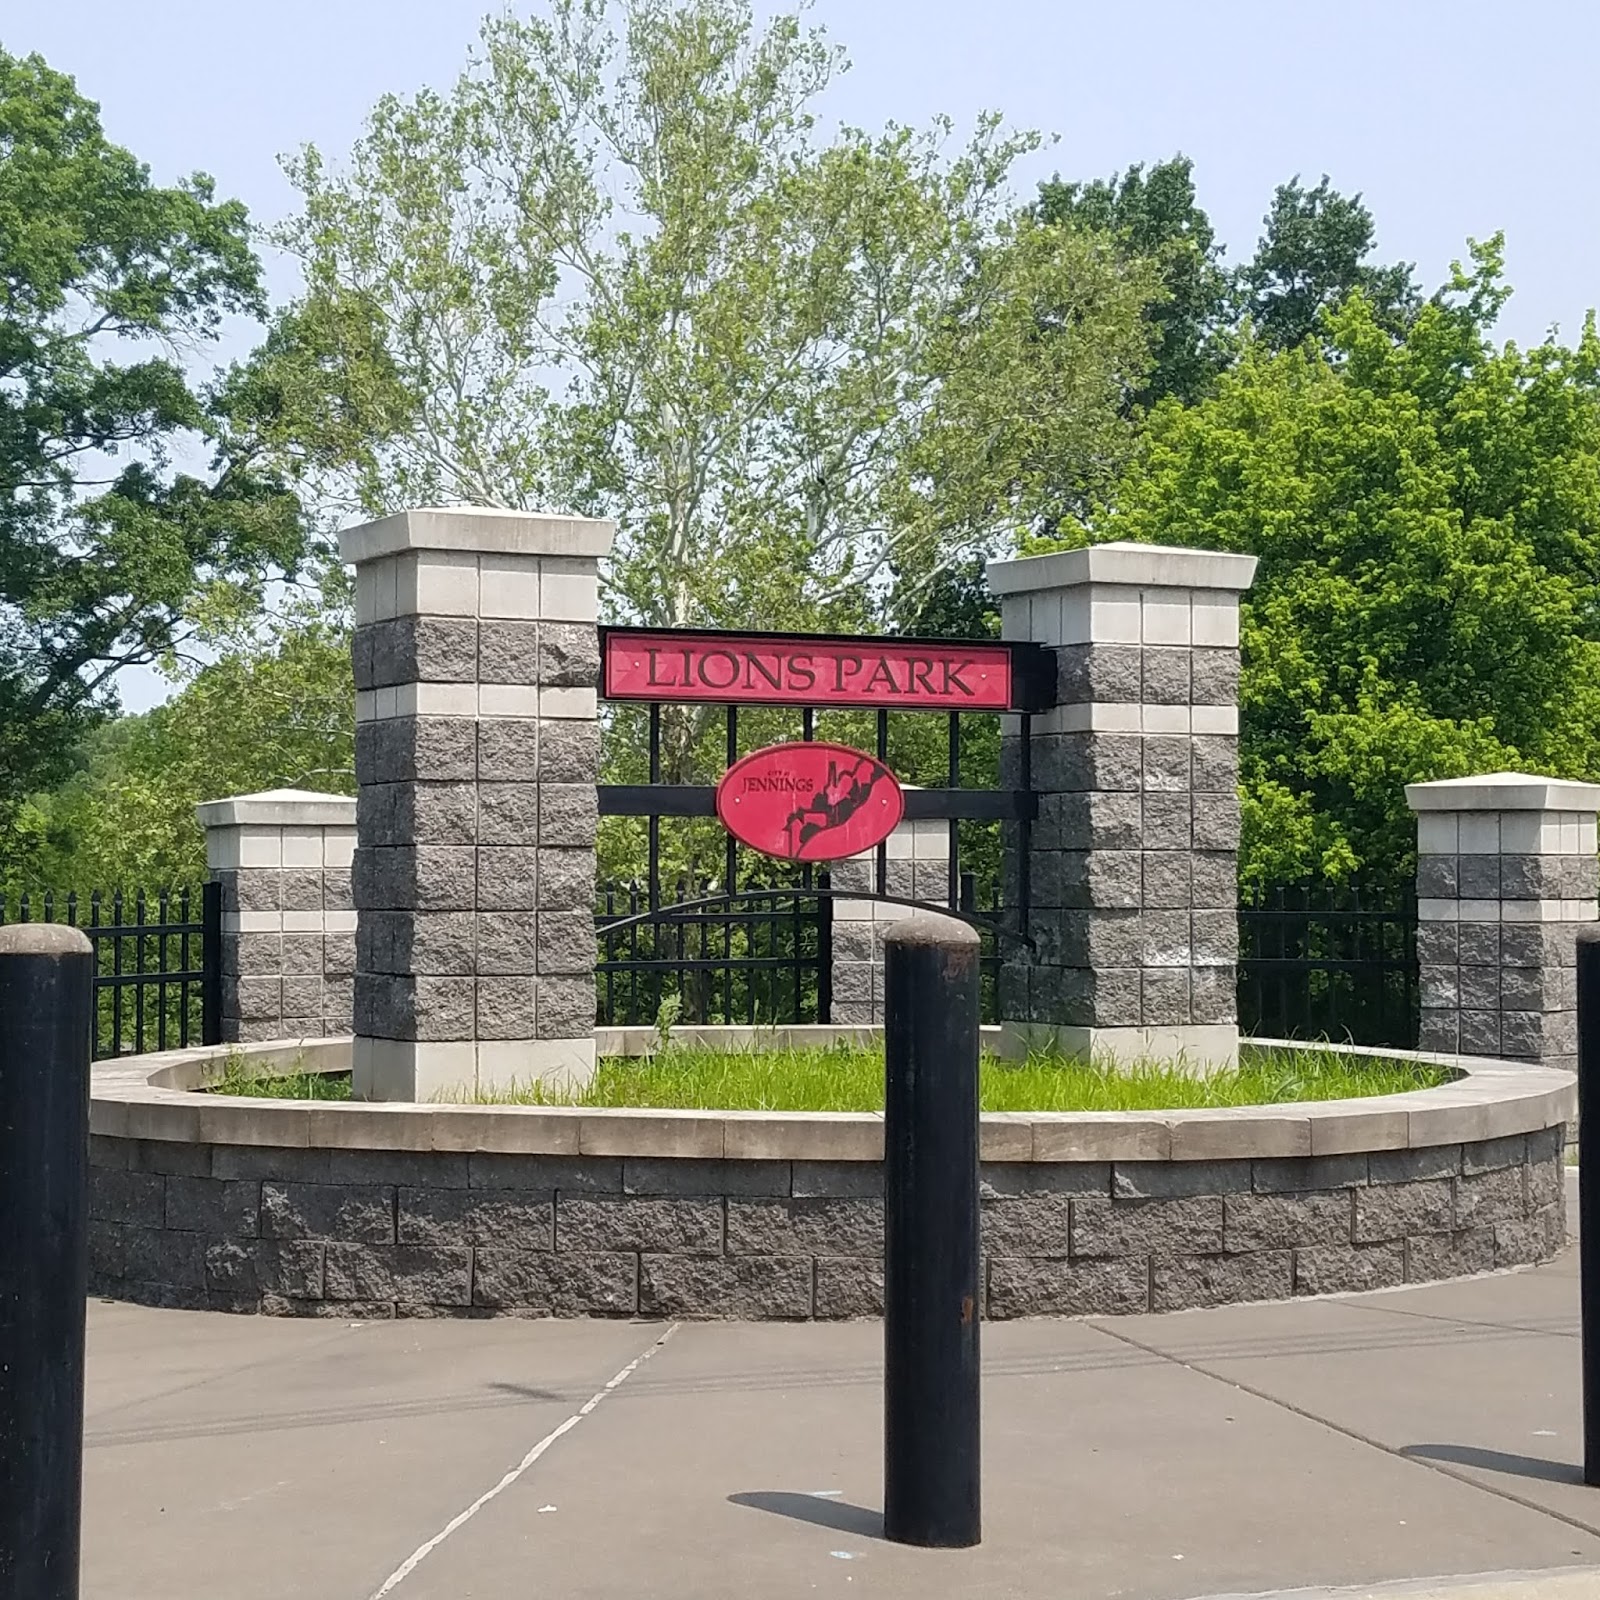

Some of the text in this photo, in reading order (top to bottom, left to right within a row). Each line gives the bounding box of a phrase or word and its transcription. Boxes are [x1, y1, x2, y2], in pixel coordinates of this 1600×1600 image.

[645, 648, 975, 696] LIONS PARK
[742, 777, 814, 793] JENNINGS
